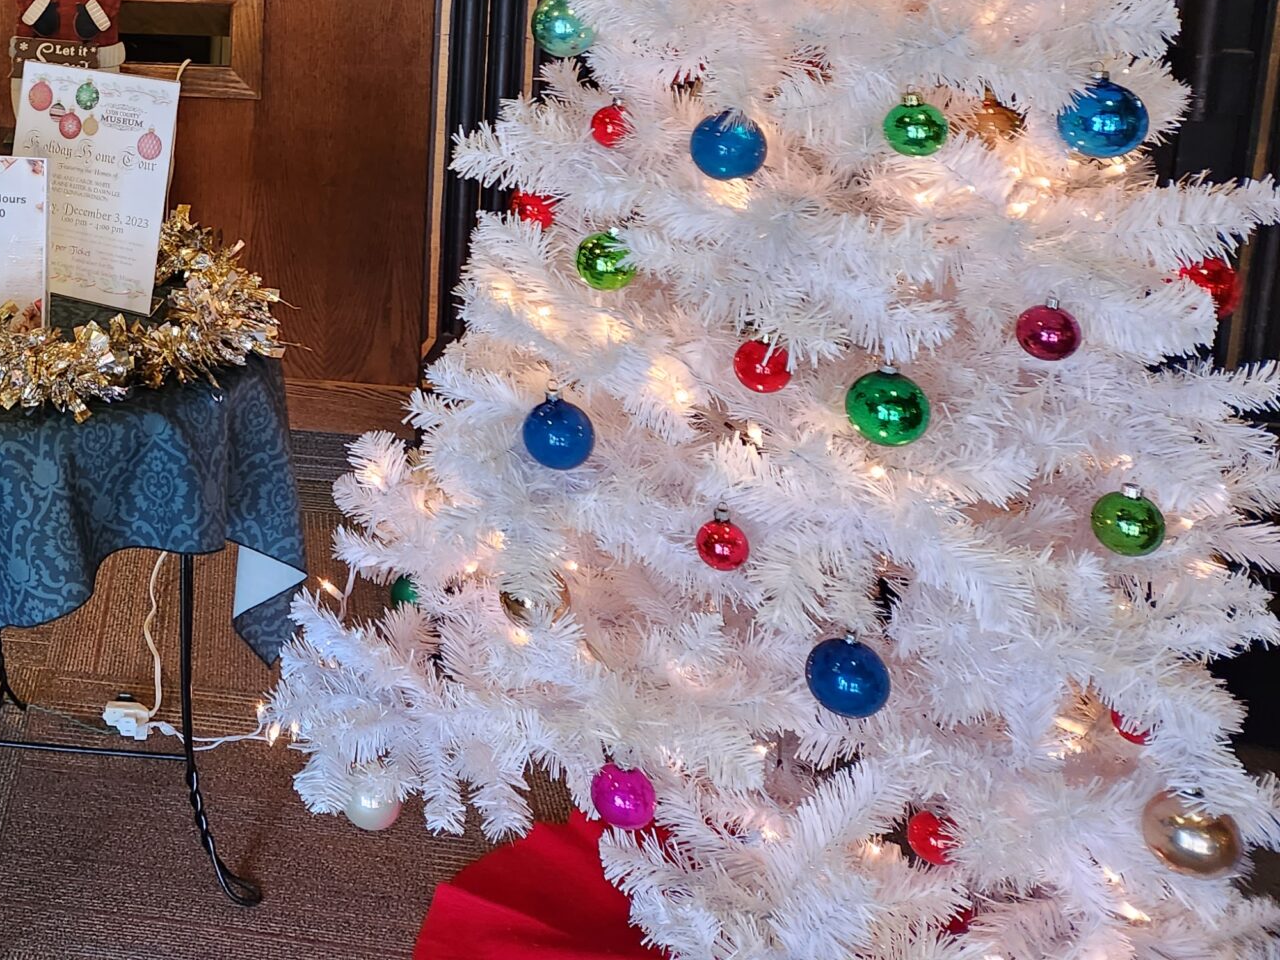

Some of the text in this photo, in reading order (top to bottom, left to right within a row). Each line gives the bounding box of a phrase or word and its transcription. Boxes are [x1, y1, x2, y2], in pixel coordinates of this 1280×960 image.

[55, 45, 88, 56] Let it
[100, 114, 144, 128] MUSEUM
[64, 202, 112, 222] December
[124, 216, 150, 229] 2023
[112, 226, 124, 234] pm
